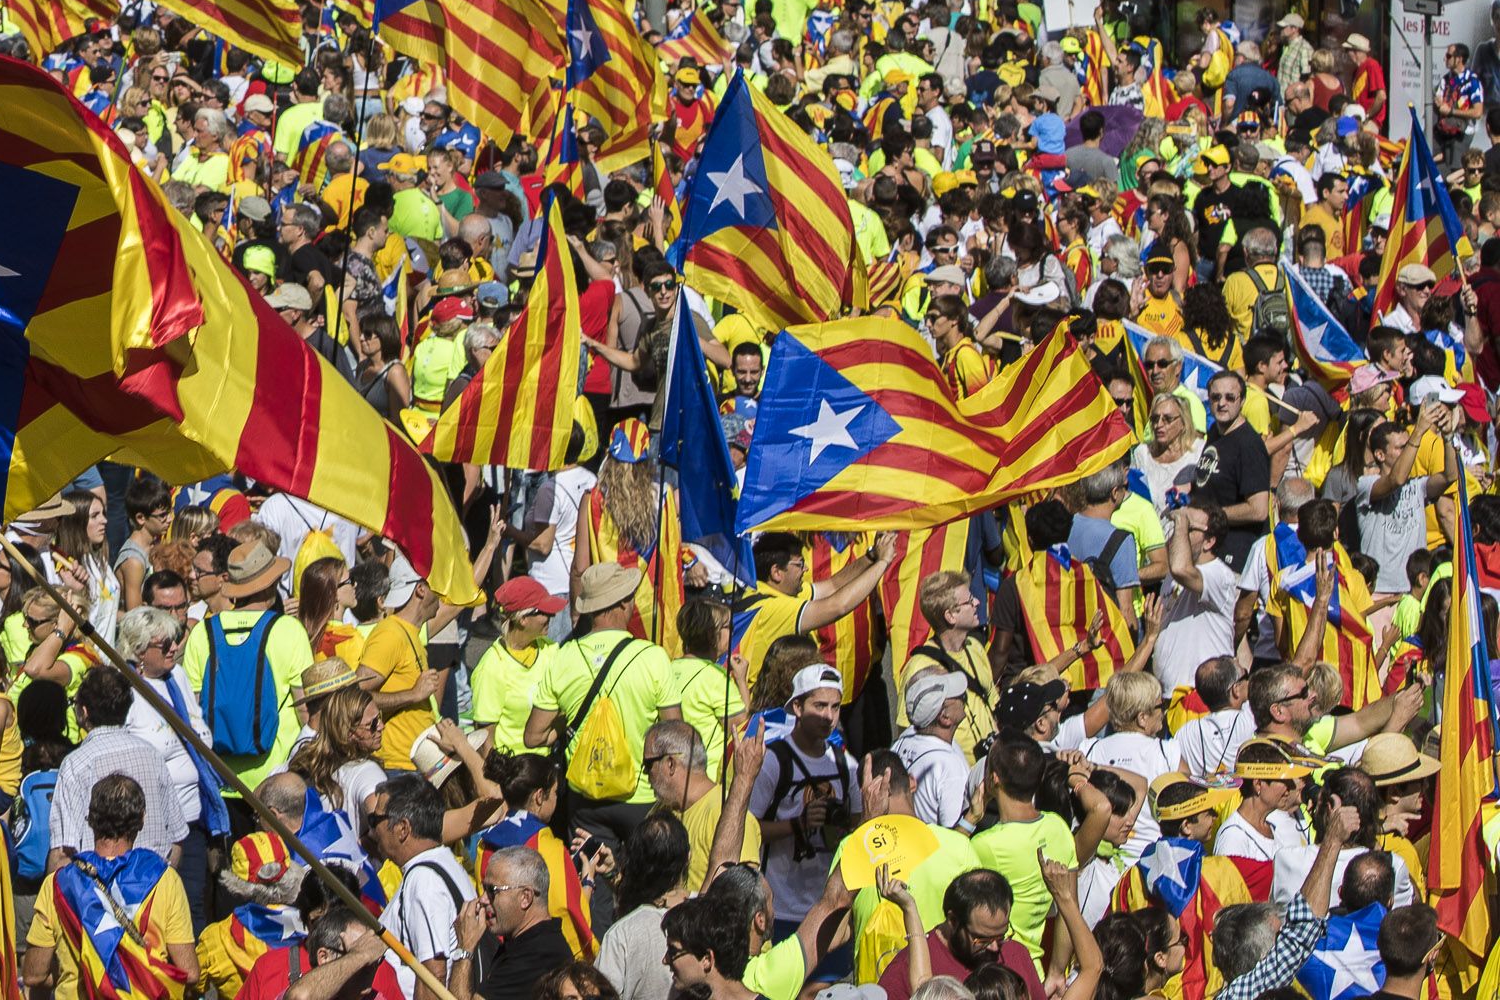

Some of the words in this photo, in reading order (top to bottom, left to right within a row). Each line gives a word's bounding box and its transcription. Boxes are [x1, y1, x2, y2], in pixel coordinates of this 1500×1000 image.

[1403, 16, 1419, 33] les
[1421, 18, 1451, 36] PME
[872, 833, 887, 849] Sí
